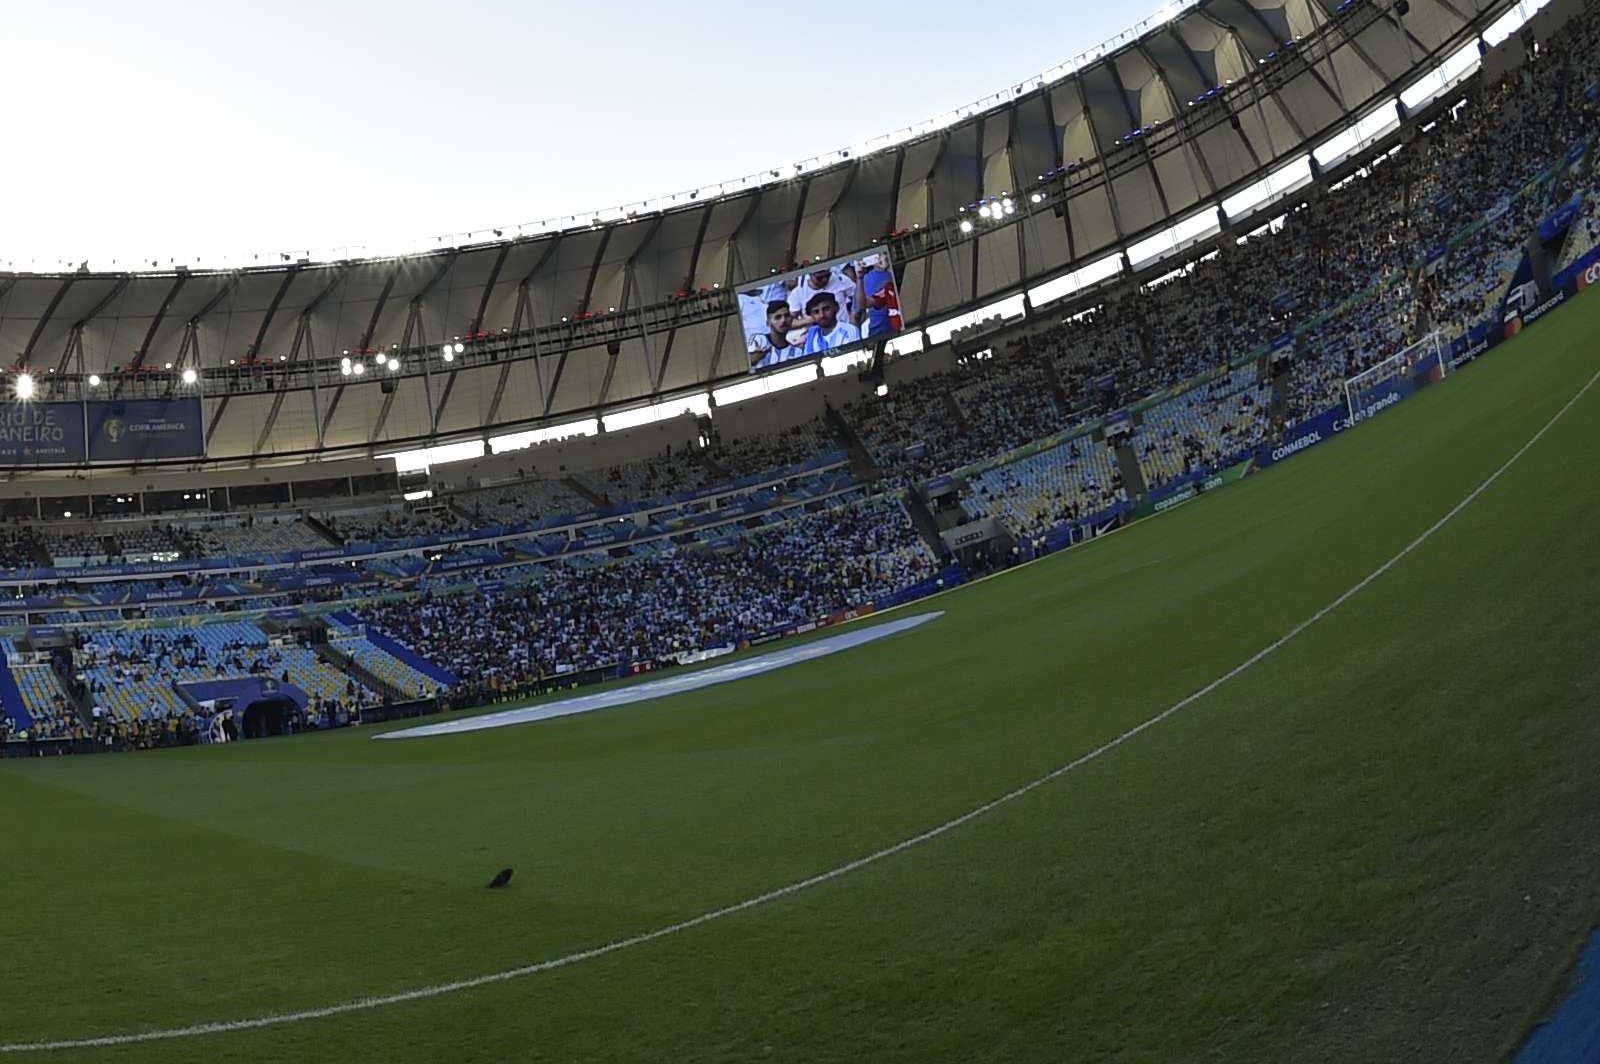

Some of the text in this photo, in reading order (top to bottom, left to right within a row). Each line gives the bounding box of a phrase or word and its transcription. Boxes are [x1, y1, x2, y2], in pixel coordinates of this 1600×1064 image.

[1523, 290, 1564, 323] mastercard
[1448, 339, 1488, 368] mastercard
[33, 410, 56, 426] DE
[129, 423, 185, 432] COPA AMERICA
[1272, 430, 1322, 461] CONMEBOL
[55, 568, 76, 577] Vibra
[82, 567, 122, 576] Continente
